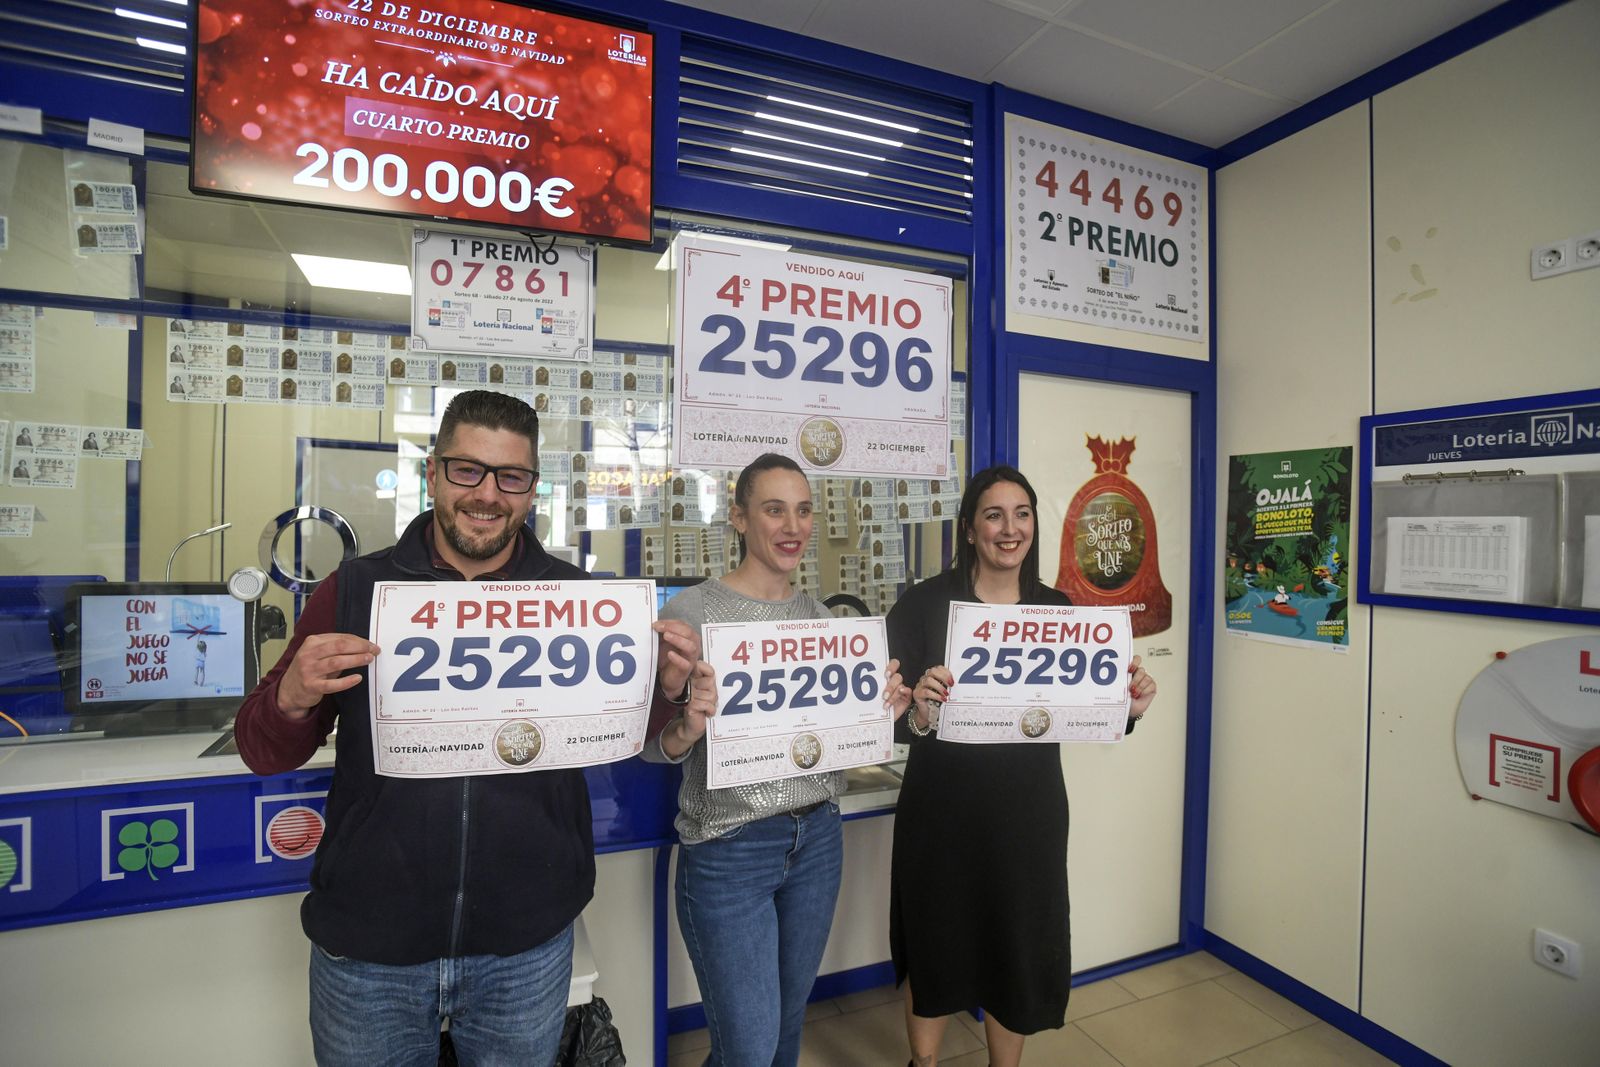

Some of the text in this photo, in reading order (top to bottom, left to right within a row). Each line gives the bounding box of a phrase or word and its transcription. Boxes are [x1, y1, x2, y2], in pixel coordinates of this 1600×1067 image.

[381, 4, 410, 20] DE
[418, 9, 538, 45] DICIEMBRE
[315, 9, 566, 66] SORTEO EXTRAORDINARIO DE NAVIDAD
[321, 60, 561, 122] HA CAÍDO AQUÍ
[93, 131, 124, 144] MADRID
[352, 109, 531, 152] CUARTO PREMIO
[292, 141, 575, 219] 200.000€
[1035, 160, 1183, 227] 44469
[1038, 210, 1179, 268] 2º PREMIO
[471, 241, 560, 266] PREMIO
[430, 258, 569, 297] 07861
[786, 262, 865, 282] VENDIDO AQUÍ
[1086, 286, 1106, 297] SORTEO
[716, 274, 922, 330] 4º PREMIO
[502, 322, 534, 332] Nacional
[698, 314, 934, 393] 25296
[744, 434, 788, 446] NAVIDAD
[880, 443, 926, 453] DICIEMBRE
[1452, 429, 1527, 449] Loteria
[1427, 450, 1463, 462] JUEVES
[1256, 479, 1313, 506] OJALÁ
[1086, 519, 1132, 547] SORTEO
[1097, 540, 1114, 553] QUE
[1093, 550, 1123, 577] UNE
[481, 582, 562, 592] VENDIDO AQUÍ
[126, 599, 156, 615] CON
[410, 598, 623, 630] 4º PREMIO
[1020, 607, 1076, 616] VENDIDO AQUÍ
[126, 616, 142, 632] EL
[775, 620, 829, 631] VENDIDO AQUÍ
[973, 620, 1113, 644] 4º PREMIO
[126, 633, 170, 650] JUEGO
[731, 633, 869, 666] 4º PREMIO
[126, 650, 168, 667] NO SE
[392, 633, 637, 692] 25296
[958, 646, 1119, 686] 25296
[126, 667, 169, 684] JUEGA
[720, 661, 879, 717] 25296
[439, 742, 485, 752] NAVIDAD
[580, 732, 626, 743] DICIEMBRE
[846, 739, 878, 750] DICIEMBRE
[754, 752, 785, 762] NAVIDAD
[1502, 745, 1543, 758] COMPRUEBE
[1514, 752, 1544, 764] PREMIO
